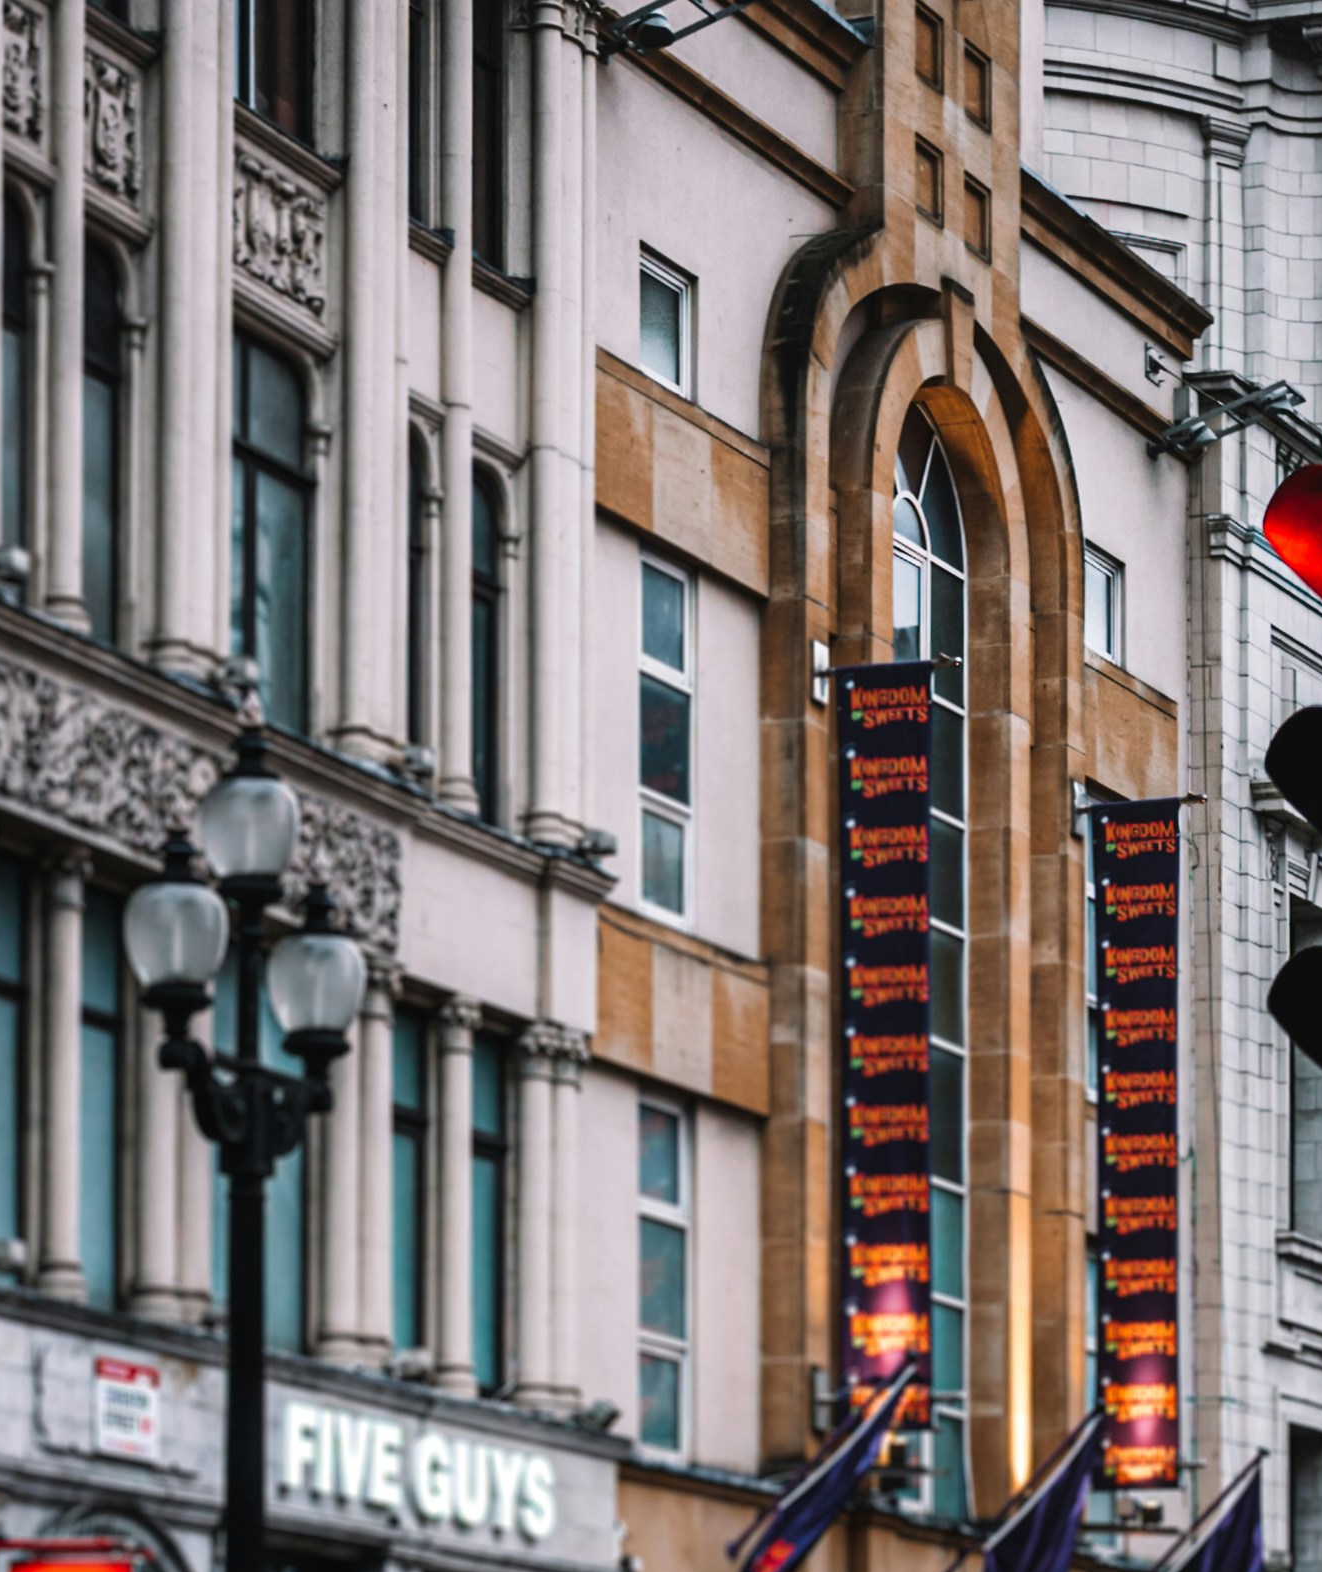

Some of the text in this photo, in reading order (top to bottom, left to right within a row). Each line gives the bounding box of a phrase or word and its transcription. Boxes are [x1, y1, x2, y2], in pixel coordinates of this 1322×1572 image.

[850, 685, 928, 710] KINGDOM
[862, 705, 929, 728] SWEETS
[850, 755, 928, 780] KINGDOM
[862, 775, 929, 798] SWEETS
[850, 825, 928, 850] KINGDOM
[1105, 821, 1175, 842] KINGDOM
[862, 845, 929, 868] SWEETS
[1116, 839, 1176, 860] SWEETS
[1105, 883, 1175, 904] KINGDOM
[1116, 901, 1176, 922] SWEETS
[1105, 946, 1175, 967] KINGDOM
[1116, 964, 1176, 985] SWEETS
[280, 1400, 556, 1541] FIVE GUYS
